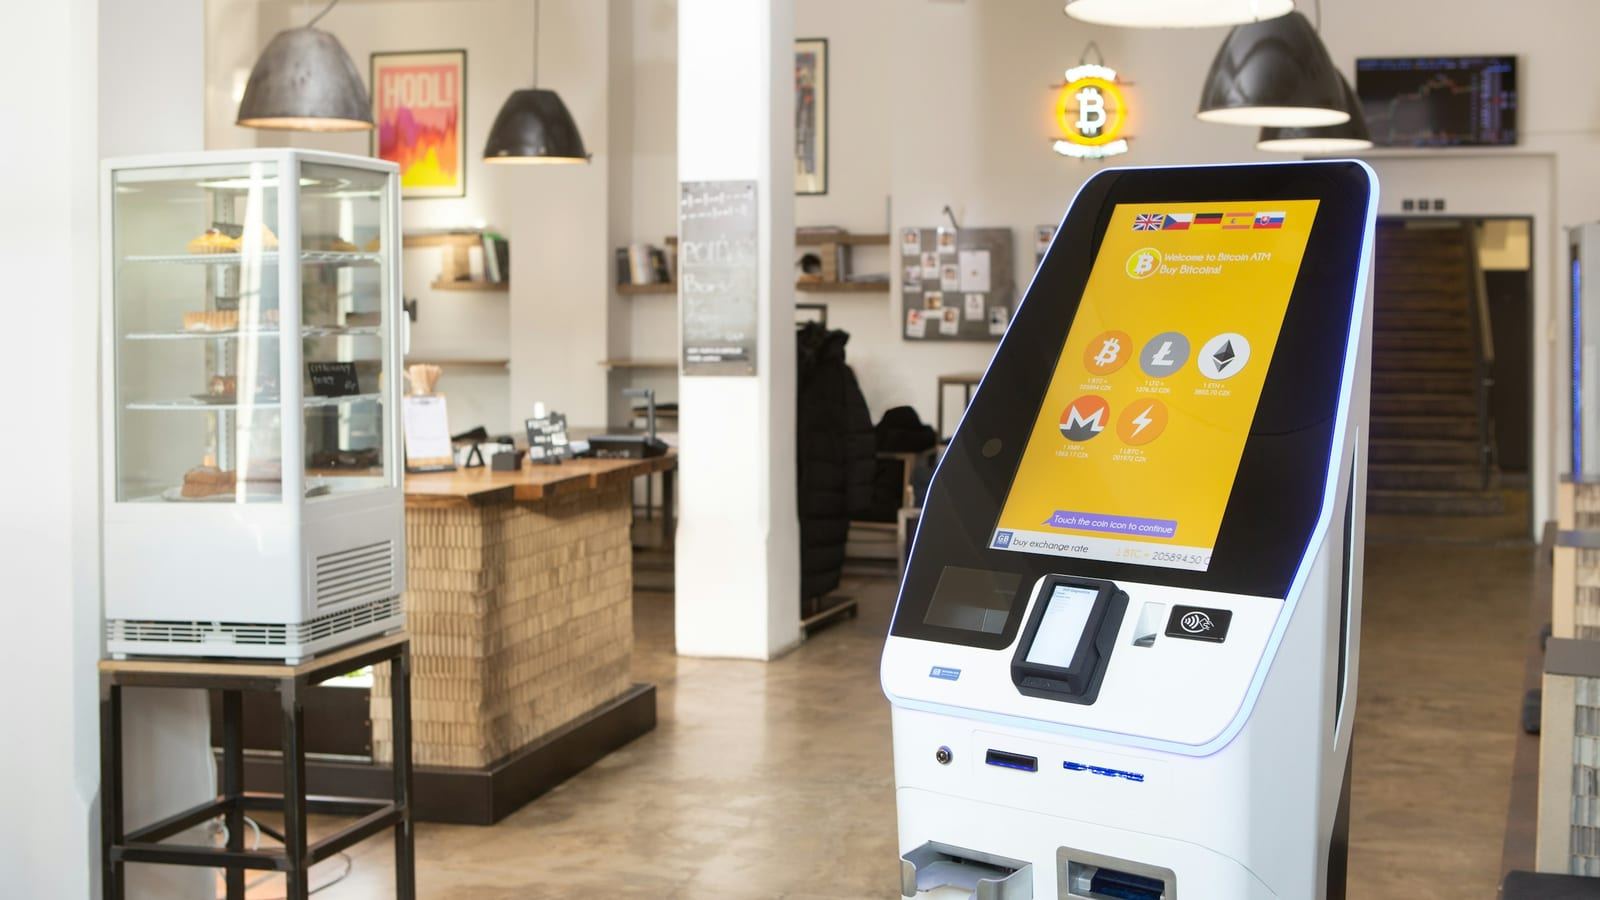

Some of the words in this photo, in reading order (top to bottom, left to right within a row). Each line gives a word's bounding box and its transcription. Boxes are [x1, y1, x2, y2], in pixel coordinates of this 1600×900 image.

[1165, 252, 1204, 262] Welcome
[1206, 253, 1215, 262] to
[1218, 252, 1248, 262] Bitcoin
[1250, 252, 1271, 261] ATM
[1160, 265, 1177, 275] Buy
[1180, 264, 1222, 274] Bitcoins!
[1054, 514, 1077, 525] Touch
[1078, 517, 1090, 526] the
[1091, 520, 1109, 528] coin
[1110, 521, 1127, 529] icon
[1129, 522, 1137, 530] to
[1138, 524, 1173, 534] continue
[1013, 537, 1028, 548] buy
[1029, 540, 1069, 551] exchange
[1071, 545, 1089, 553] rate
